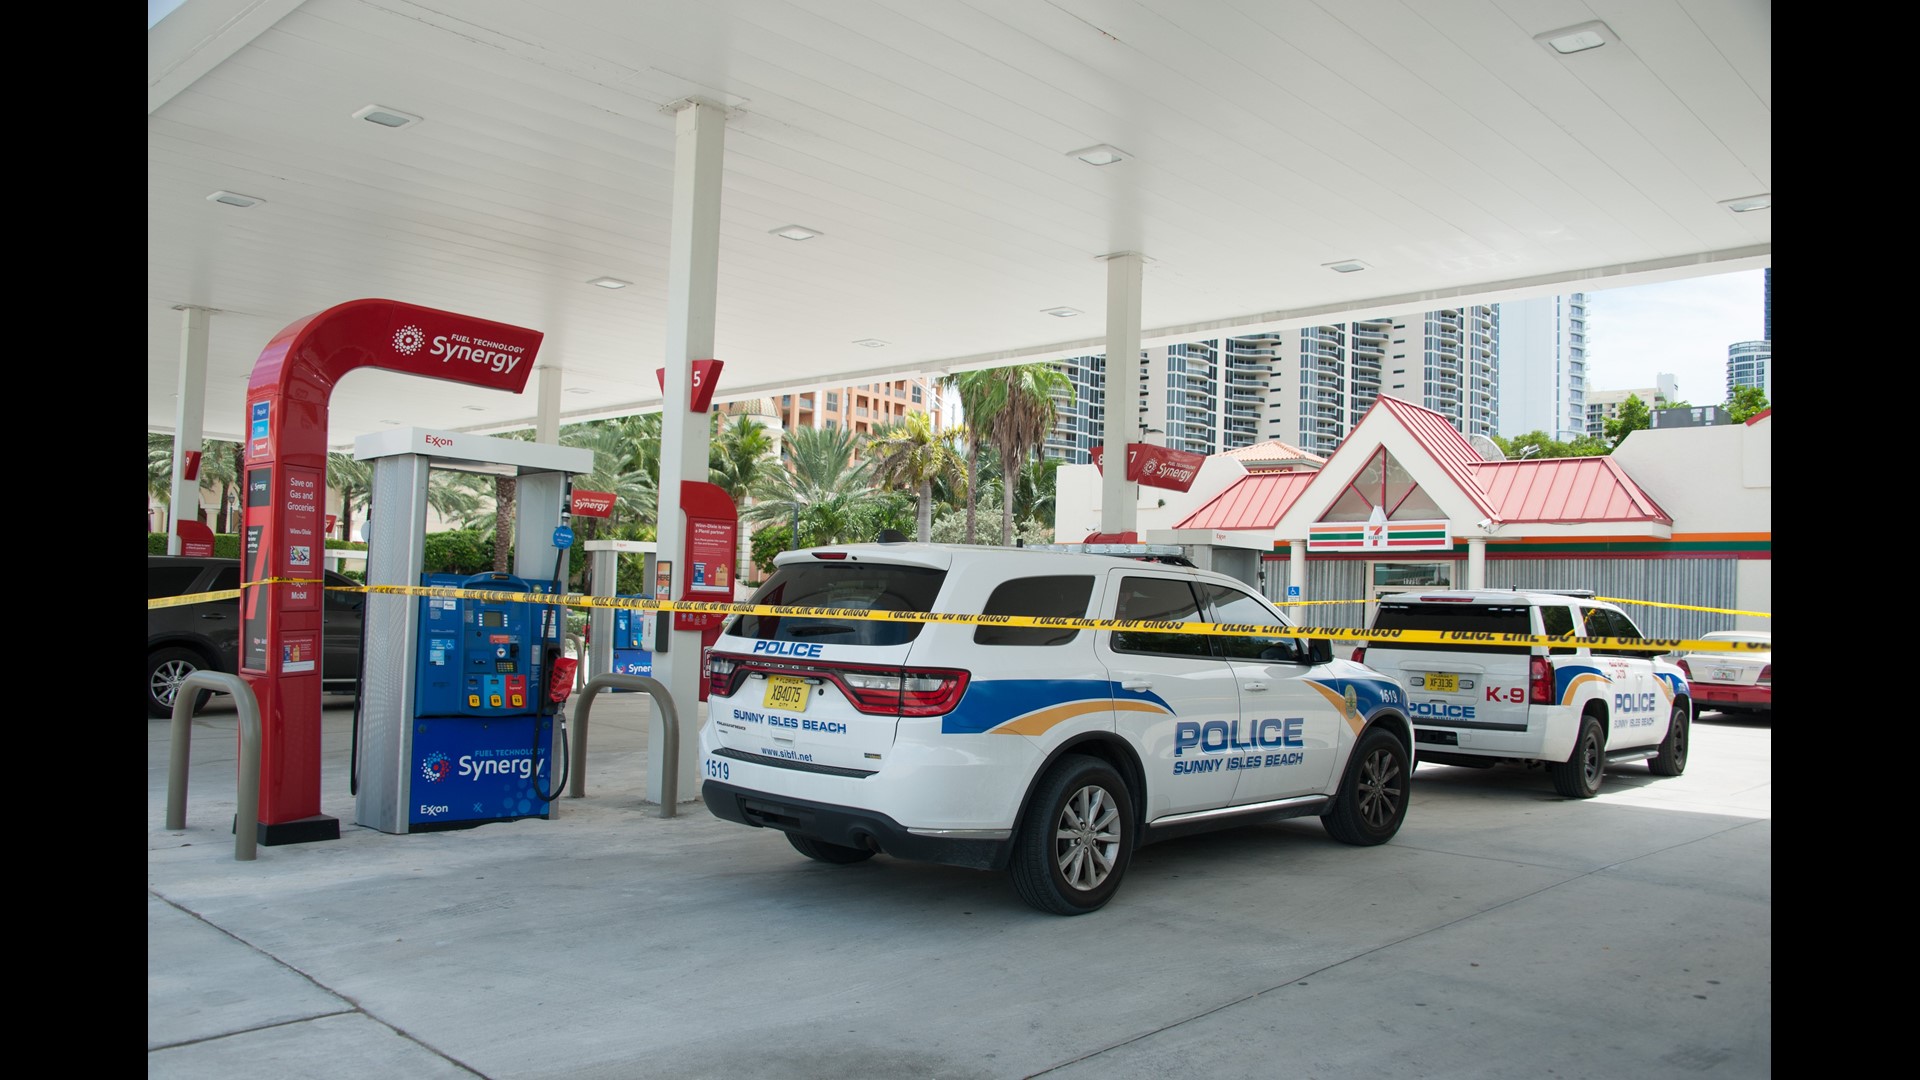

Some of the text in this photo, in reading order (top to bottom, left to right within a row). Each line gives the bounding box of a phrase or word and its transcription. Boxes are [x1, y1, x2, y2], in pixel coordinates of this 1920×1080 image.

[451, 333, 525, 353] FUEL TECHNOLOGY
[429, 336, 521, 374] Synergy
[693, 370, 701, 387] 5
[425, 434, 453, 448] Exxon
[1129, 451, 1137, 464] 7
[1156, 463, 1193, 482] Synergy
[290, 477, 305, 487] Save
[290, 489, 314, 500] Gas and
[287, 501, 315, 512] Groceries
[573, 499, 608, 512] Synergy
[1369, 525, 1383, 547] 7
[291, 592, 307, 600] Mobil
[753, 640, 824, 658] POLICE
[751, 660, 815, 671] DODGE
[771, 684, 802, 703] XB4075
[1379, 689, 1398, 703] 1519
[1486, 686, 1525, 703] K-9
[1409, 703, 1476, 718] POLICE
[1615, 692, 1655, 714] POLICE
[733, 709, 847, 734] SUNNY ISLES BEACH
[1614, 717, 1654, 729] SUNNY ISLES BEACH
[1174, 717, 1304, 757] POLICE
[760, 746, 813, 762] www.sibfl.net
[459, 755, 545, 781] Synergy
[706, 758, 730, 780] 1519
[1173, 752, 1304, 775] SUNNY ISLES BEACH
[420, 804, 449, 816] Exxon
